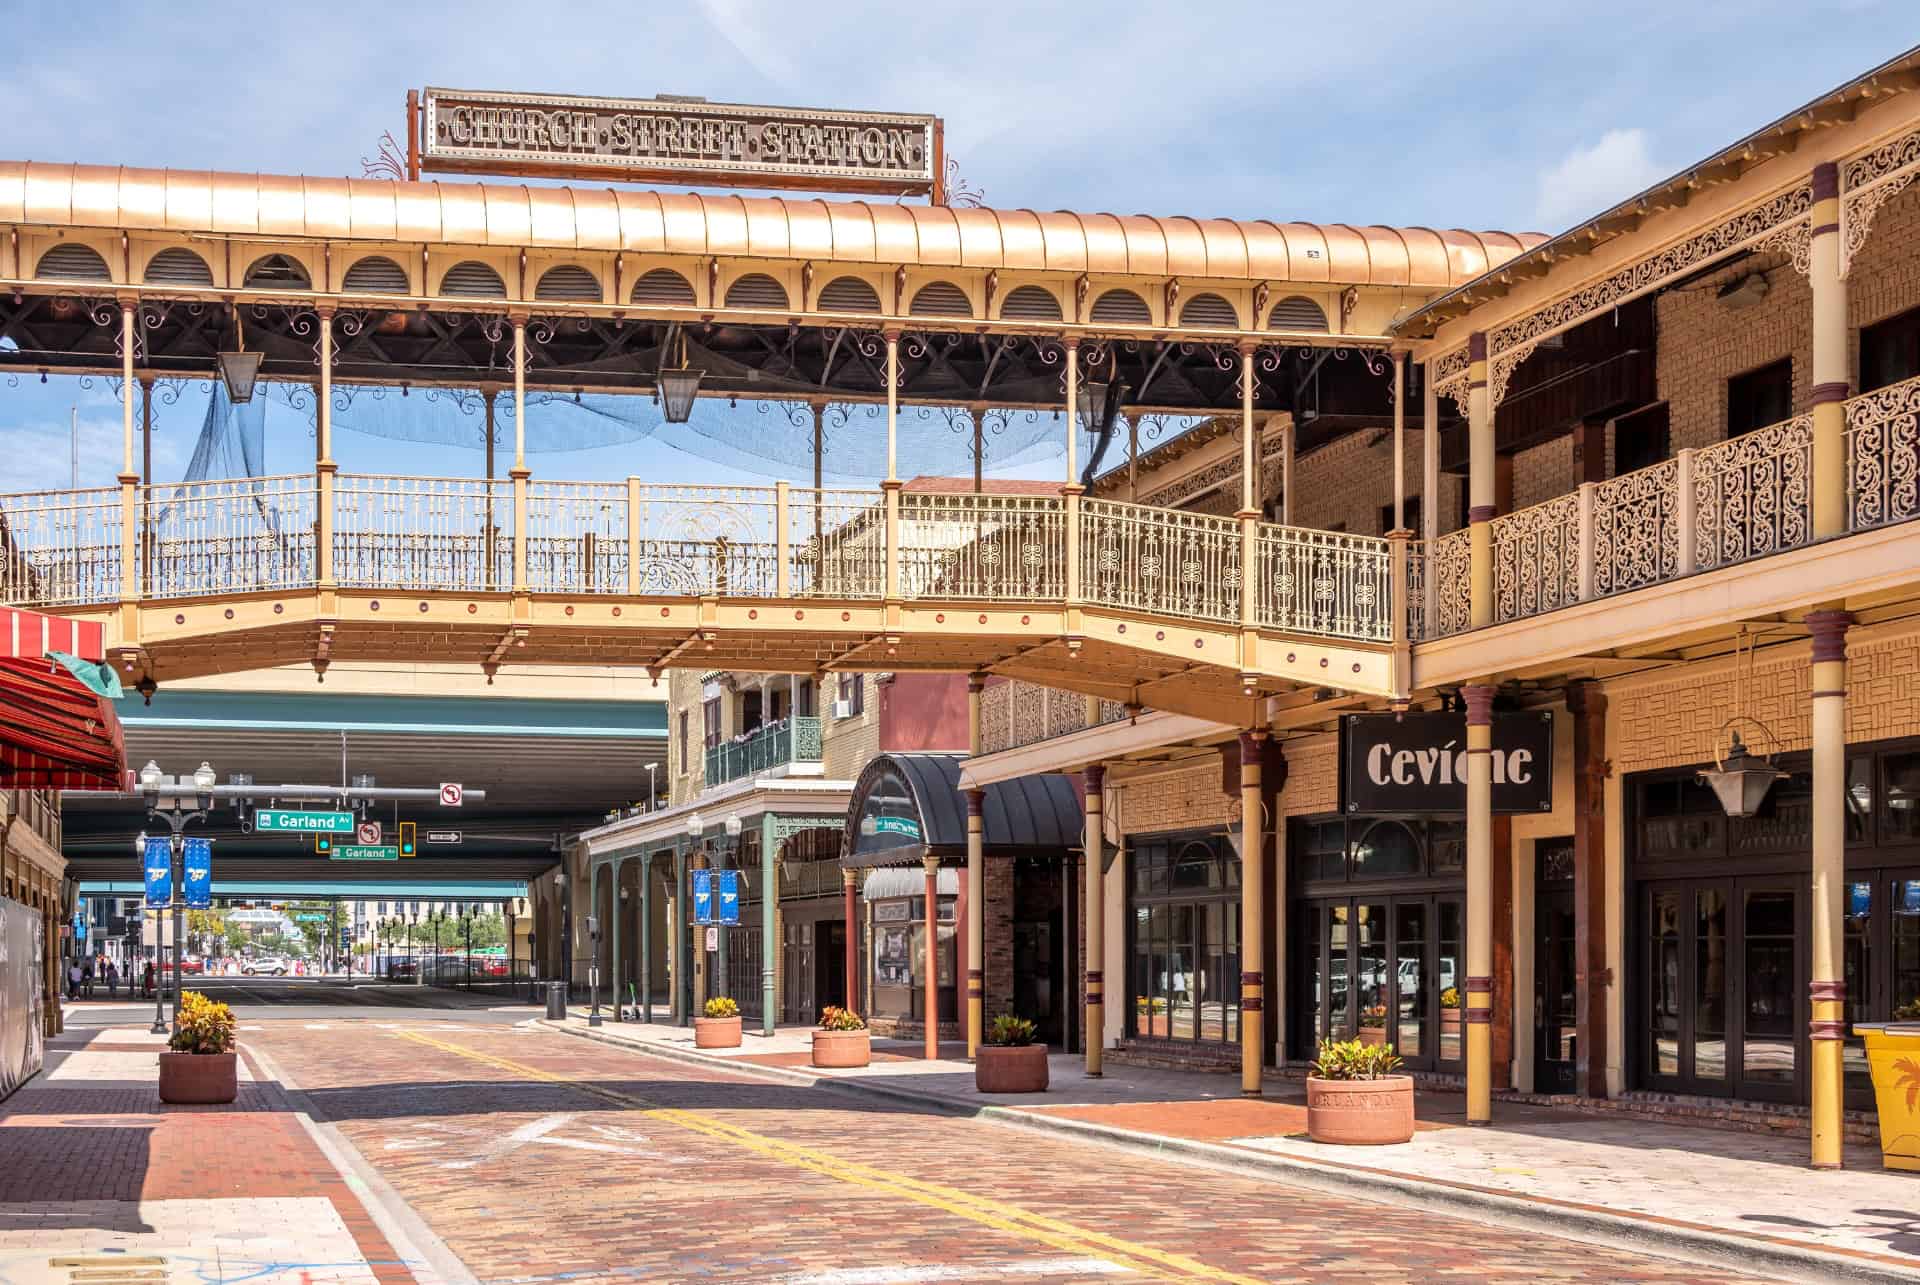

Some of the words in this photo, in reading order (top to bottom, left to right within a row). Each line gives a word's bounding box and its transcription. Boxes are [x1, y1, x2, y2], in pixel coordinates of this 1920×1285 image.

[450, 106, 598, 147] CHURCH
[610, 114, 748, 155] STREET
[761, 122, 914, 164] STATION
[279, 814, 335, 829] Garland
[345, 848, 385, 858] Garland
